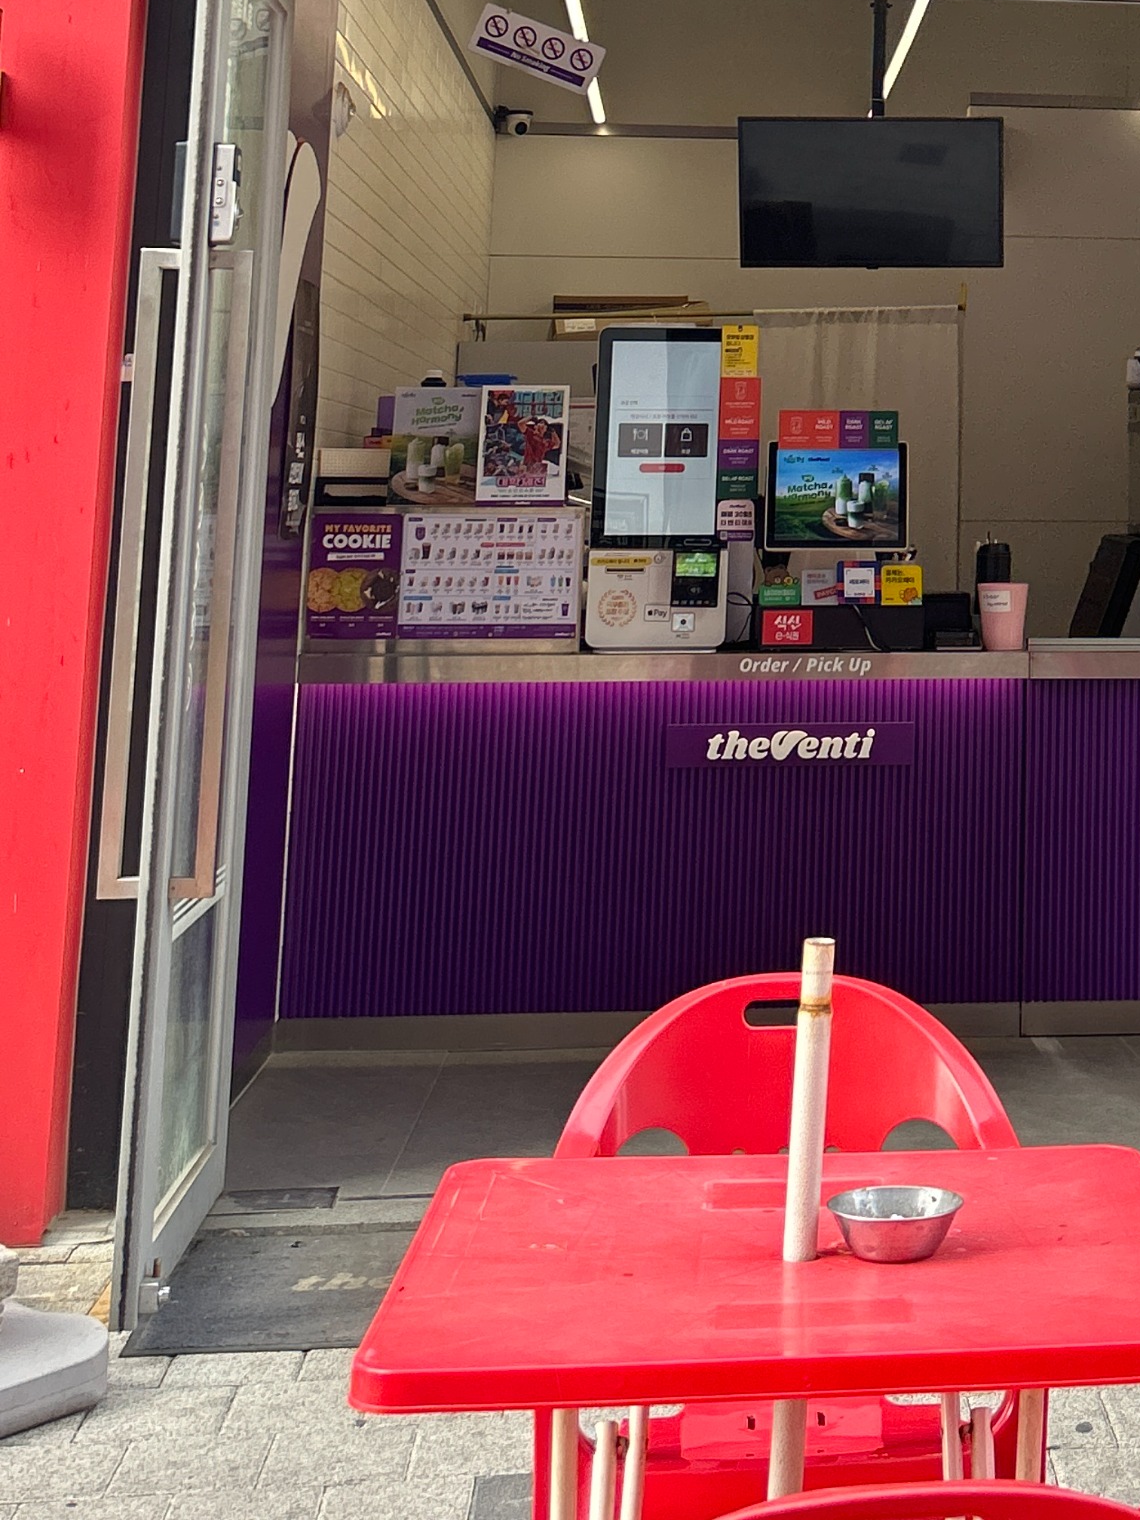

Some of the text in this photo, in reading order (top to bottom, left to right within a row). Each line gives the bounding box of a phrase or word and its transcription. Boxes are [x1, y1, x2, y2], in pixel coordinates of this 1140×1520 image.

[415, 405, 459, 416] Matcha
[787, 482, 828, 493] Matcha
[325, 524, 392, 533] MY FAVORITE
[322, 533, 391, 549] COOKIE
[653, 608, 668, 618] Pay
[774, 615, 802, 631] 식신
[739, 656, 872, 677] Order / Pick Up
[706, 728, 876, 761] theVenti
